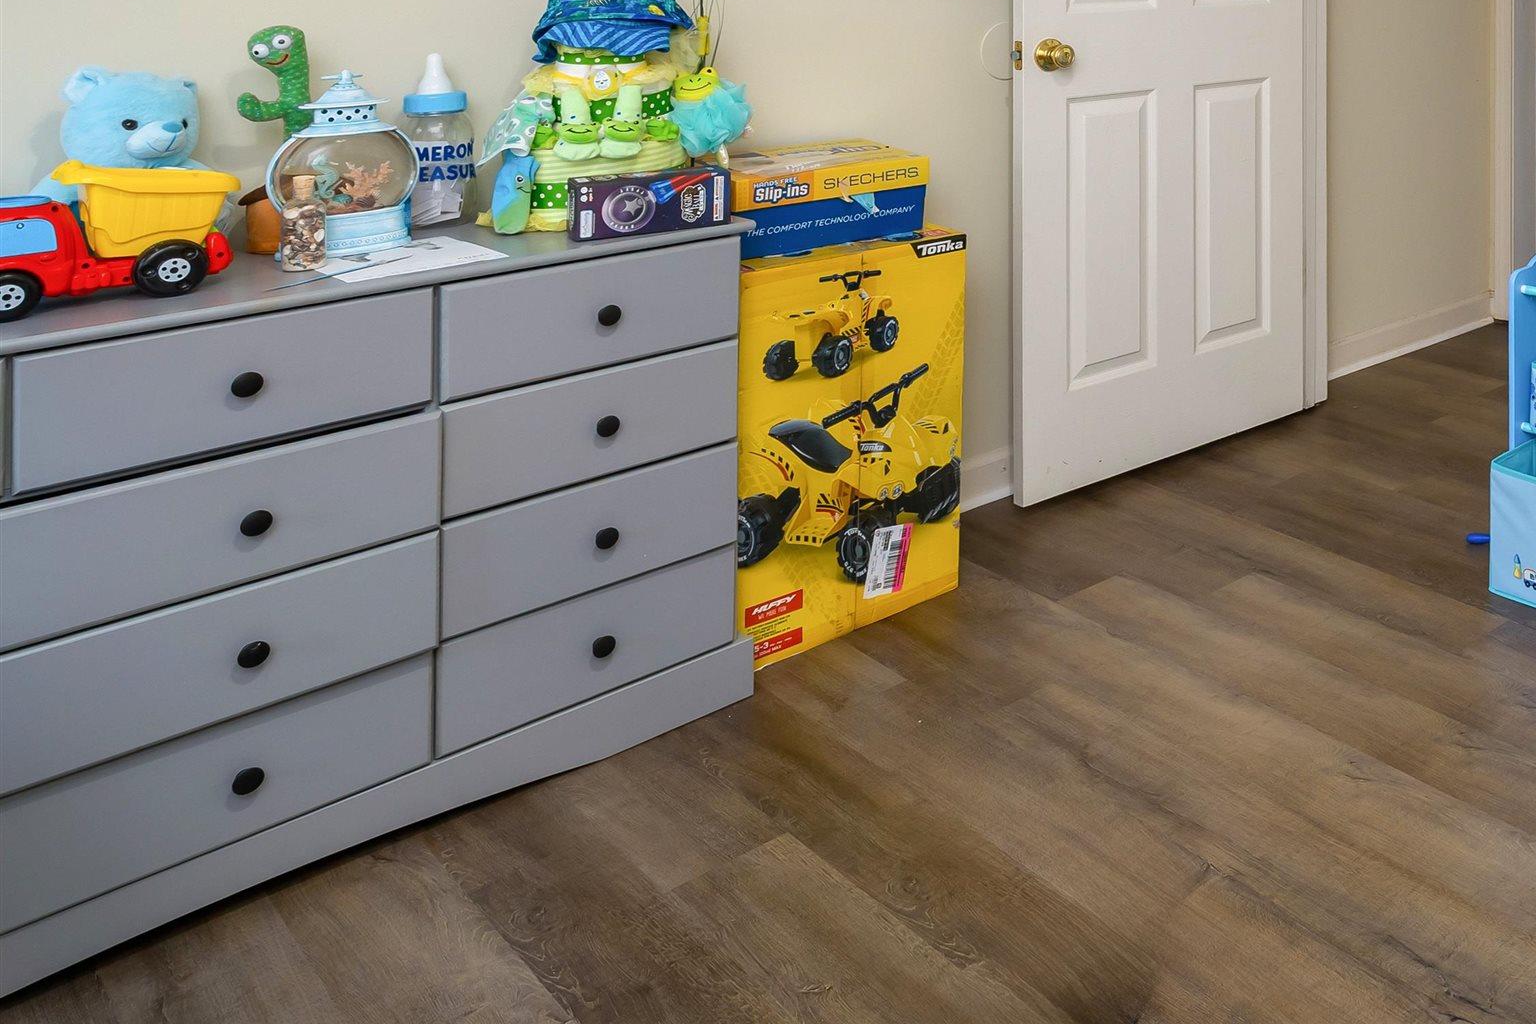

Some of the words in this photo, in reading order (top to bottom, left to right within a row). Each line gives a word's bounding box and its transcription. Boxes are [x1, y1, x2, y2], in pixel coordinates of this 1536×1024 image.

[752, 179, 778, 189] HANDS
[779, 176, 798, 185] FREE
[823, 166, 920, 190] SKECHERS
[754, 183, 809, 203] Slip-ins
[747, 226, 765, 238] THE
[766, 220, 812, 235] COMFORT
[814, 211, 873, 227] TECHNOLOGY
[873, 204, 915, 218] COMPANY
[917, 239, 964, 257] Tonka
[860, 442, 884, 451] Tonka
[751, 594, 797, 615] HUFFY
